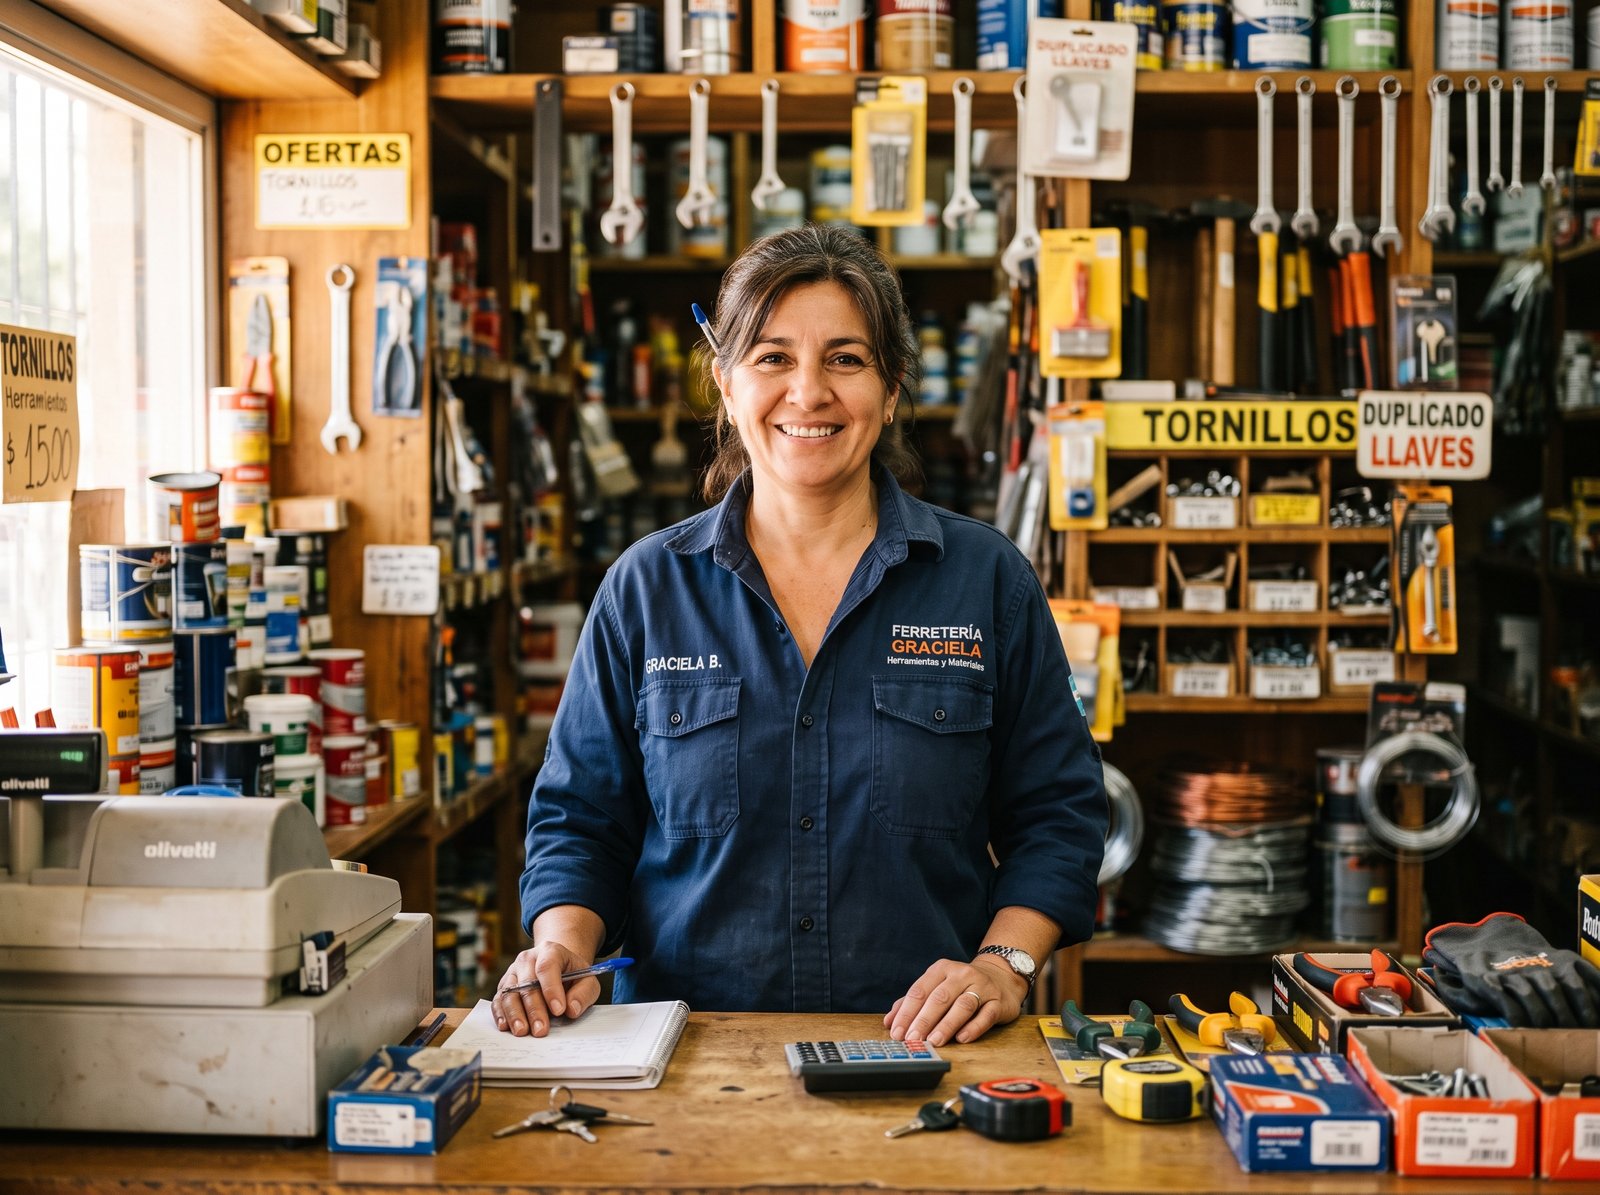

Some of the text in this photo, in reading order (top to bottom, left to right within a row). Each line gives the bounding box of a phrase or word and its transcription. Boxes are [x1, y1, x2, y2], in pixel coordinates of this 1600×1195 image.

[1037, 40, 1128, 55] DUPLICADO
[1052, 55, 1112, 69] LLAVES
[264, 142, 401, 163] OFERTAS
[1, 332, 73, 384] TORNILLOS
[1363, 403, 1485, 428] DUPLICADO
[1143, 409, 1357, 444] TORNILLOS
[7, 423, 73, 489] $ 1500
[1371, 434, 1475, 469] LLAVES
[892, 624, 983, 641] FERRETERÍA
[891, 639, 982, 658] GRACIELA
[645, 654, 722, 674] GRACIELA B.
[887, 656, 985, 671] Herramientas y Materiales
[1, 777, 50, 790] olivetti
[144, 841, 217, 859] olivetti
